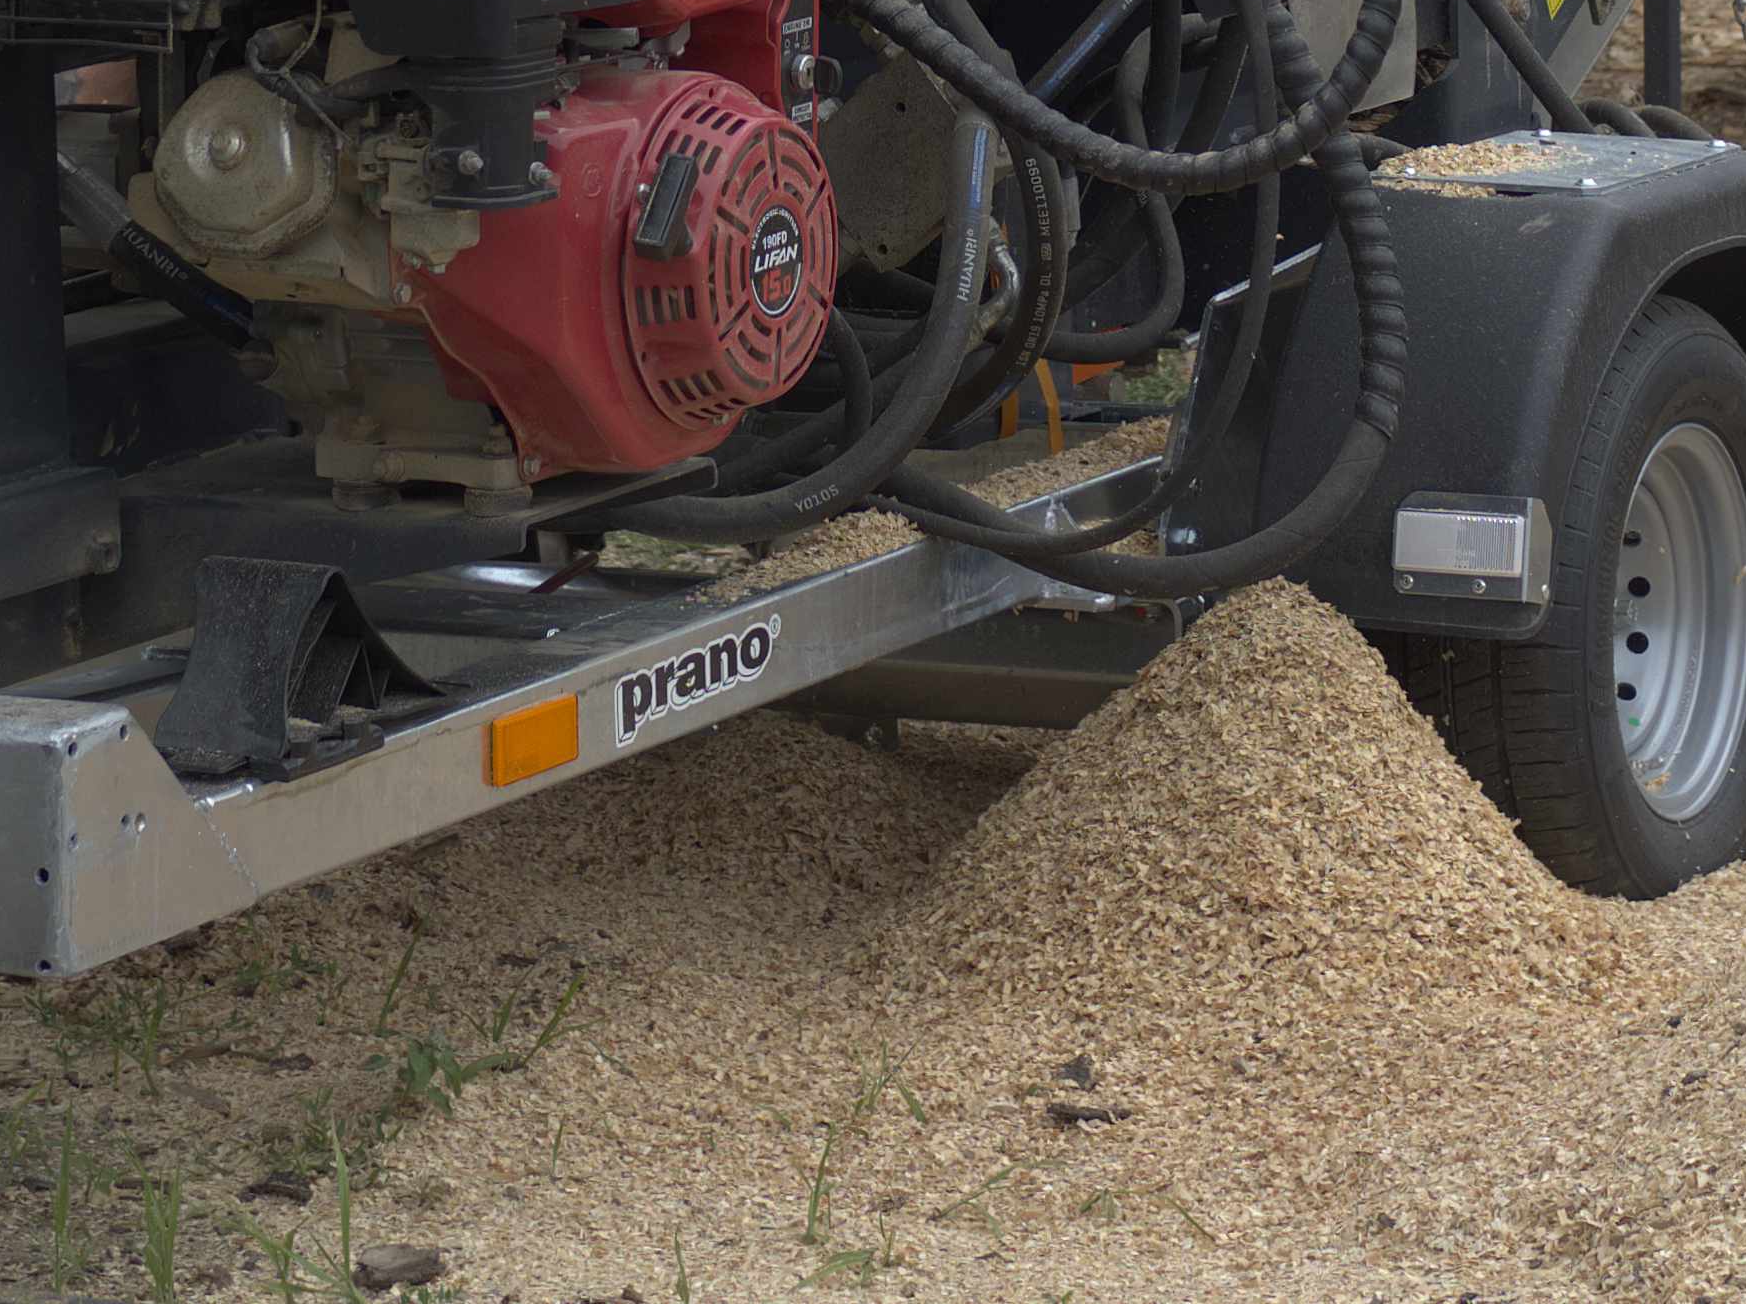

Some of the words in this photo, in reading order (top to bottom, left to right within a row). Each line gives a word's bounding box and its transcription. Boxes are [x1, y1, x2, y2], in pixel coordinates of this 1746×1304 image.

[762, 230, 788, 250] 190FD
[754, 244, 799, 273] LIFAN
[615, 623, 772, 747] prano
